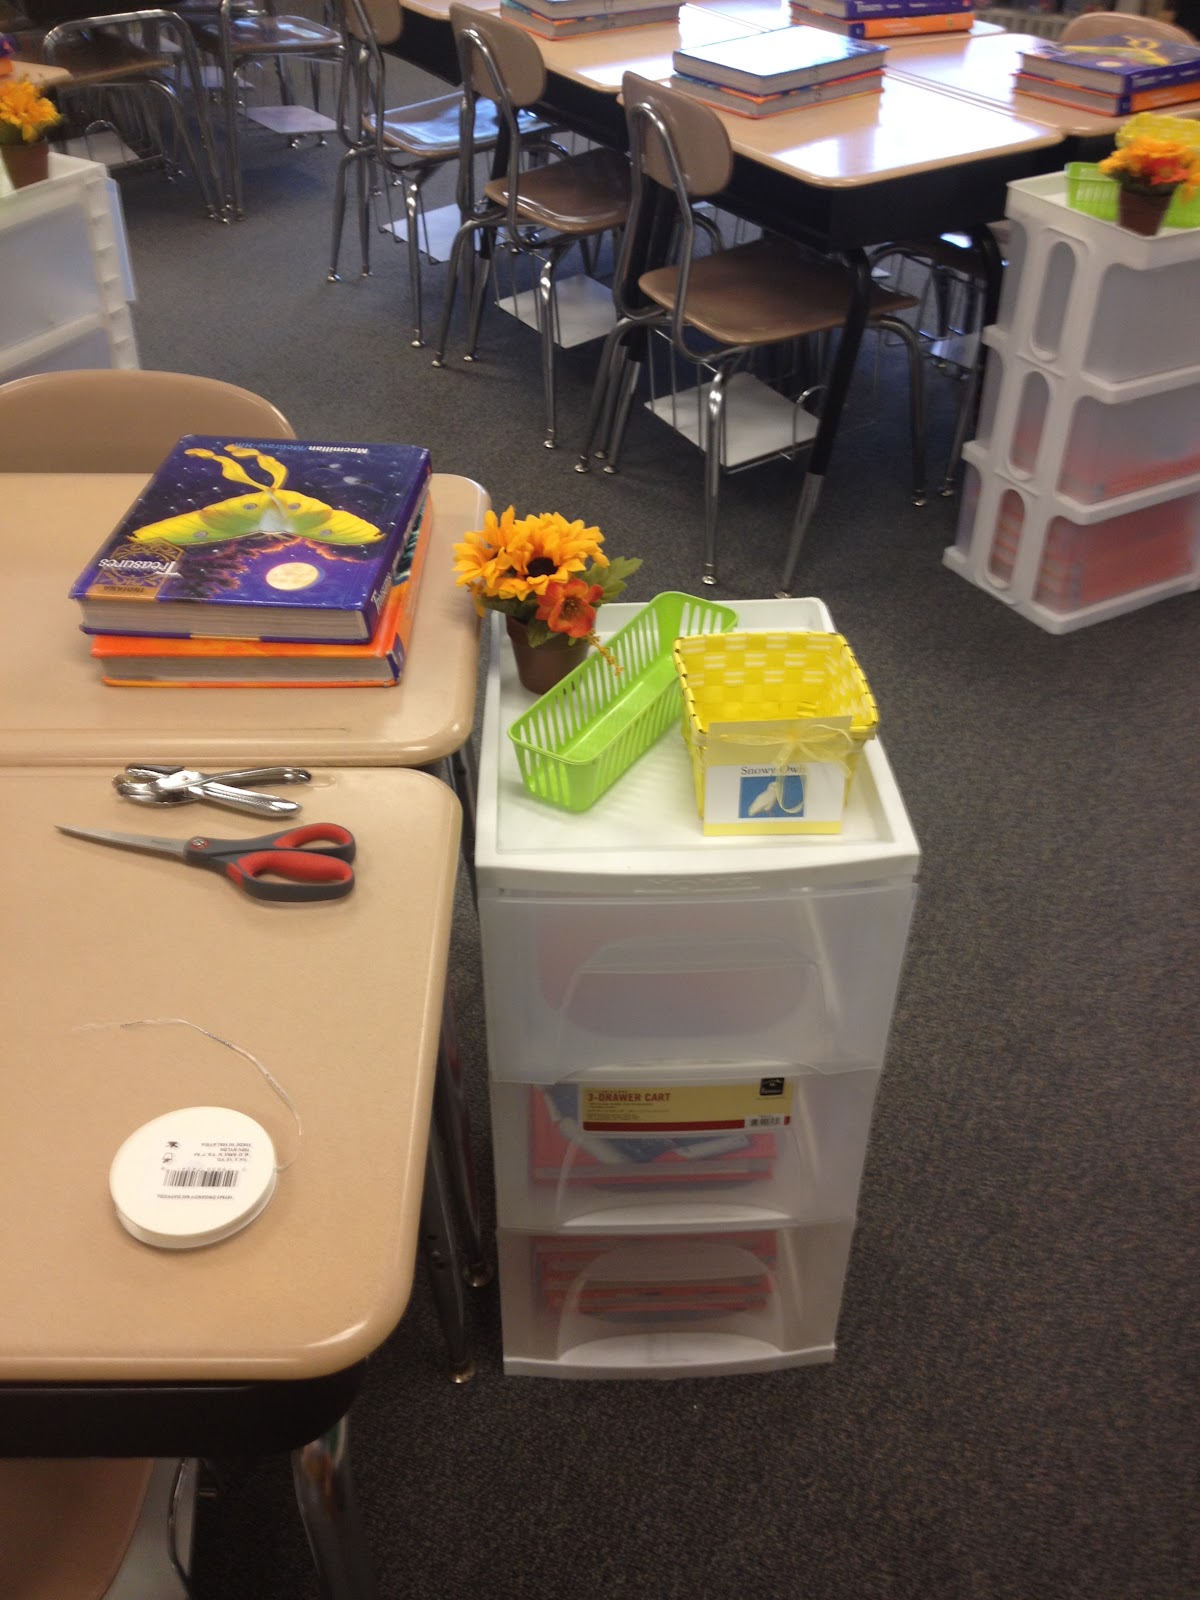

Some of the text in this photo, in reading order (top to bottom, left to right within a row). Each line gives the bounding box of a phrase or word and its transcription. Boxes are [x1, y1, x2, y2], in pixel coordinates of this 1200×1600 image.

[98, 558, 184, 579] Treasures
[740, 765, 776, 776] Snowy
[587, 1092, 671, 1102] 3-DRAWER CART
